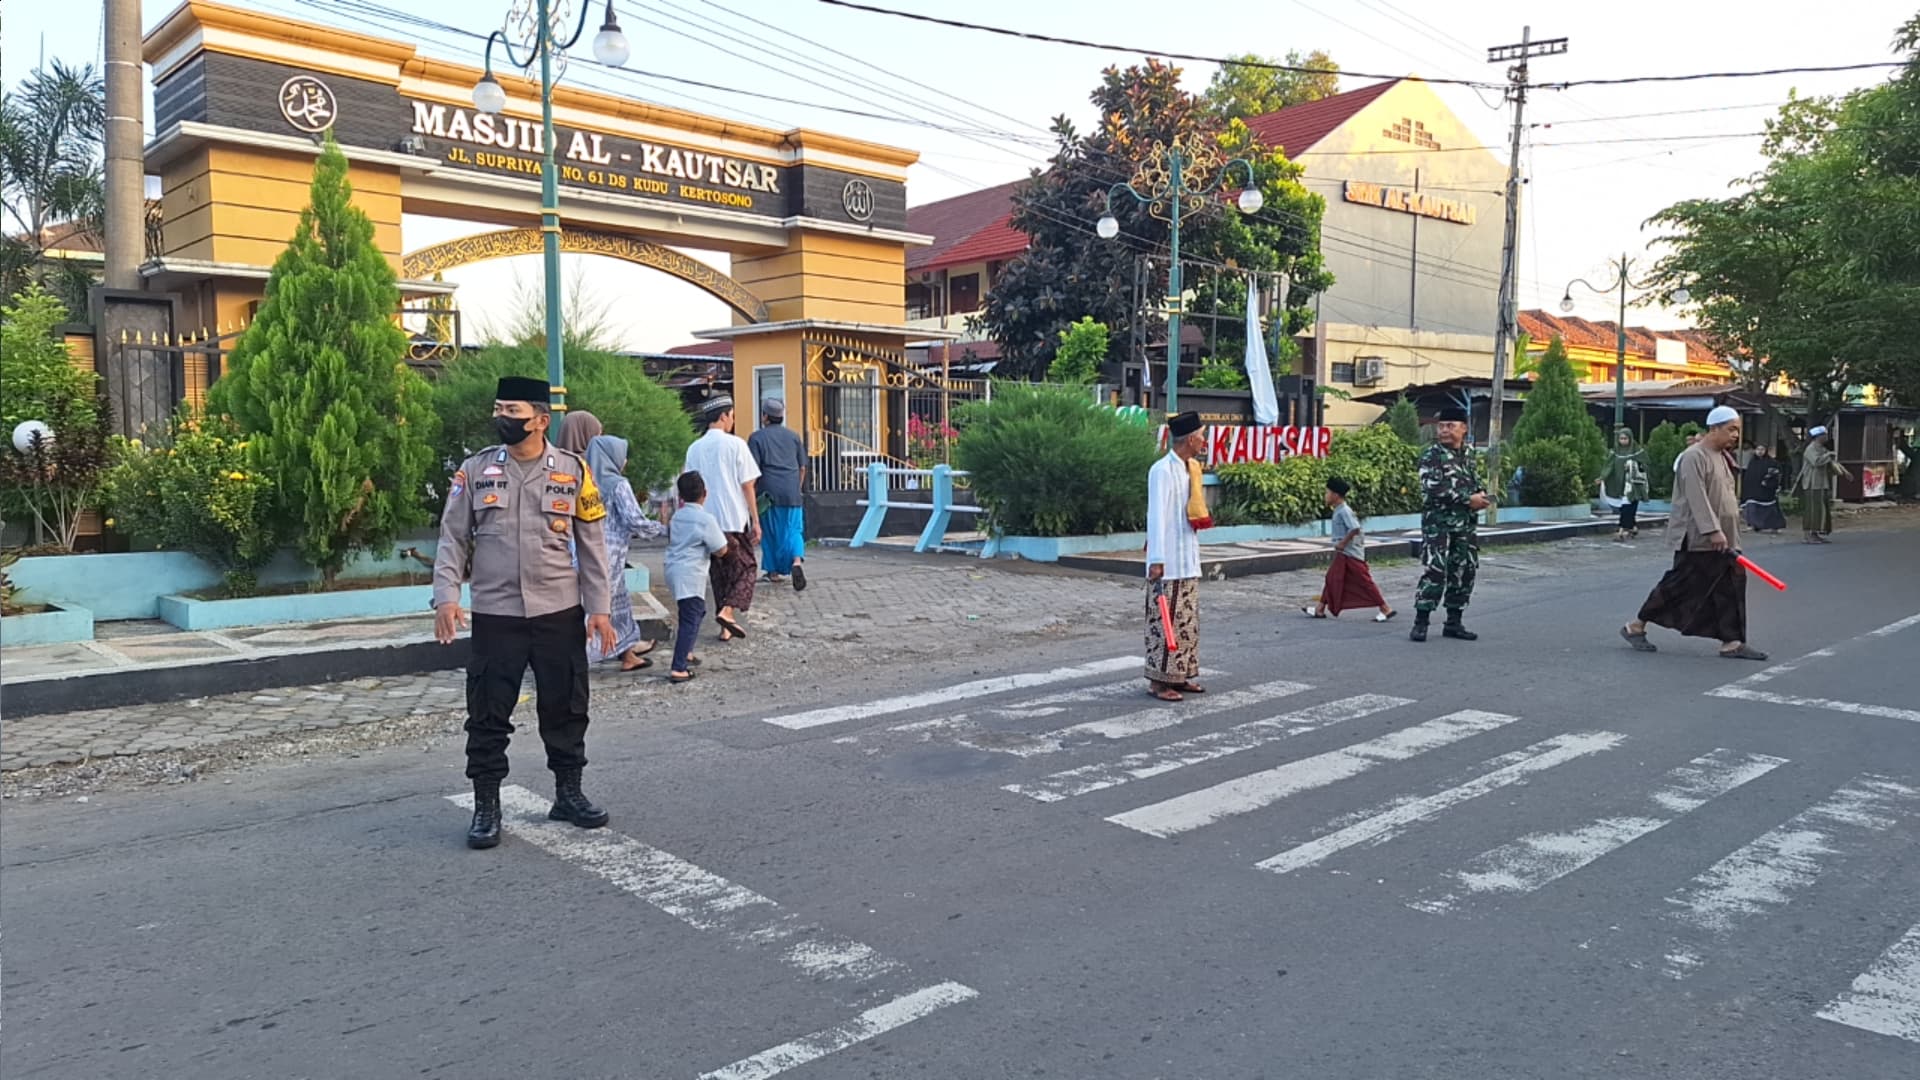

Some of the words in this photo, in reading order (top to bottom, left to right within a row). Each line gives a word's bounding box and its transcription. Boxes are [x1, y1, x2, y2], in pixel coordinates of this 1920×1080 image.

[412, 101, 557, 153] MASJID
[566, 131, 611, 165] AL
[620, 153, 632, 161] -
[641, 143, 780, 193] KAUTSAR
[448, 147, 472, 164] JL.
[475, 152, 543, 175] SUPRIYA
[562, 166, 584, 181] NO.
[588, 170, 604, 184] 61
[608, 174, 627, 188] DS
[633, 178, 669, 194] KUDU
[680, 185, 753, 207] KERTOSONO
